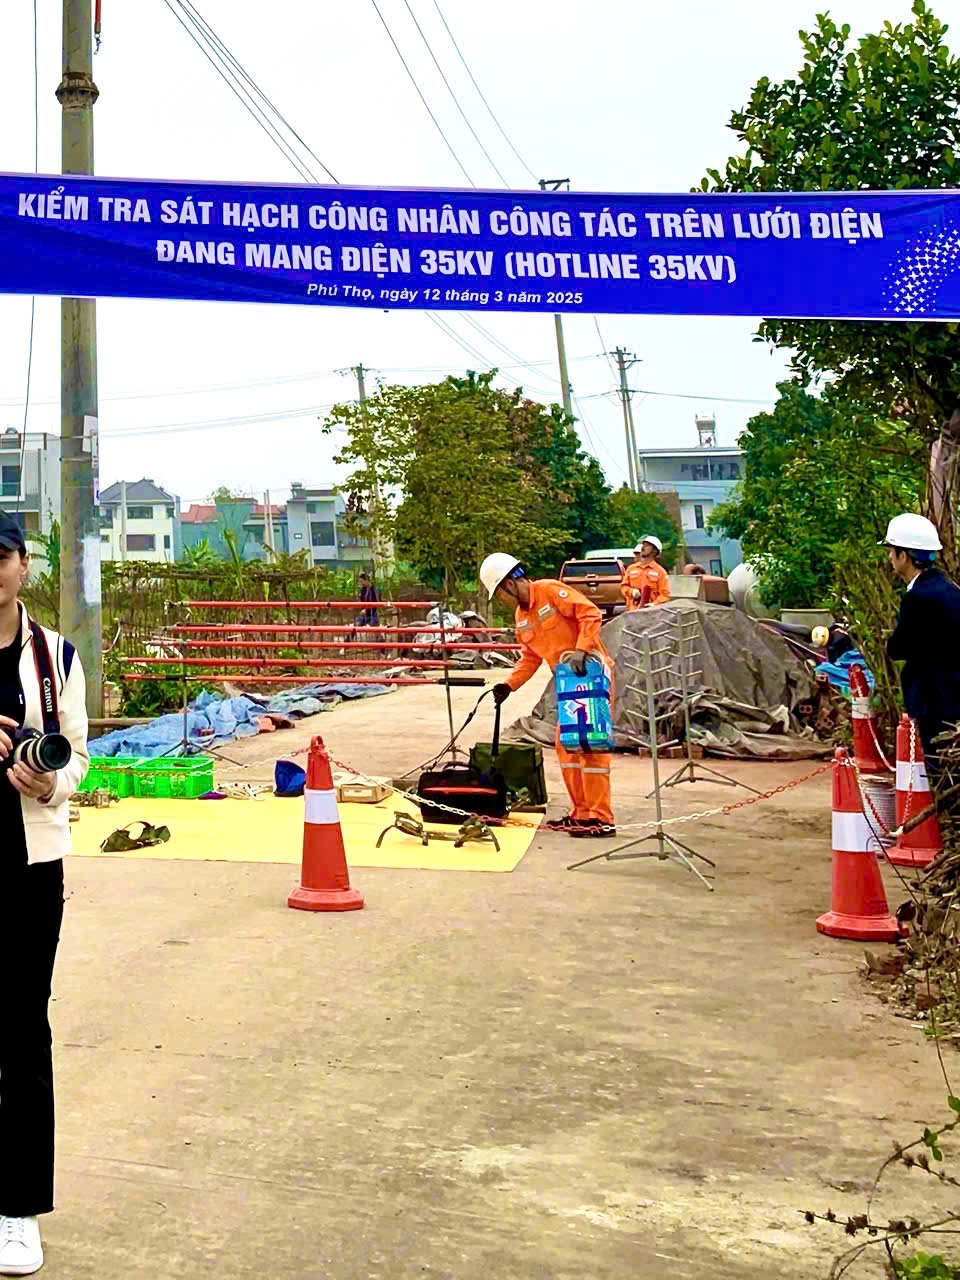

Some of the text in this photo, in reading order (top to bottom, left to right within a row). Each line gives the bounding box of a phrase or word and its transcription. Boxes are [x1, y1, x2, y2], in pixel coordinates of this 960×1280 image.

[18, 185, 884, 245] KIỂM TRA SÁT HẠCH CÔNG NHÂN CÔNG TÁC TRÊN LƯỚI ĐIỆN
[155, 239, 737, 284] ĐANG MANG ĐIỆN 35KV (HOTLINE 35KV)
[306, 283, 583, 305] Phú Thọ, ngày 12 tháng 3 năm 2025
[42, 677, 53, 712] Canon
